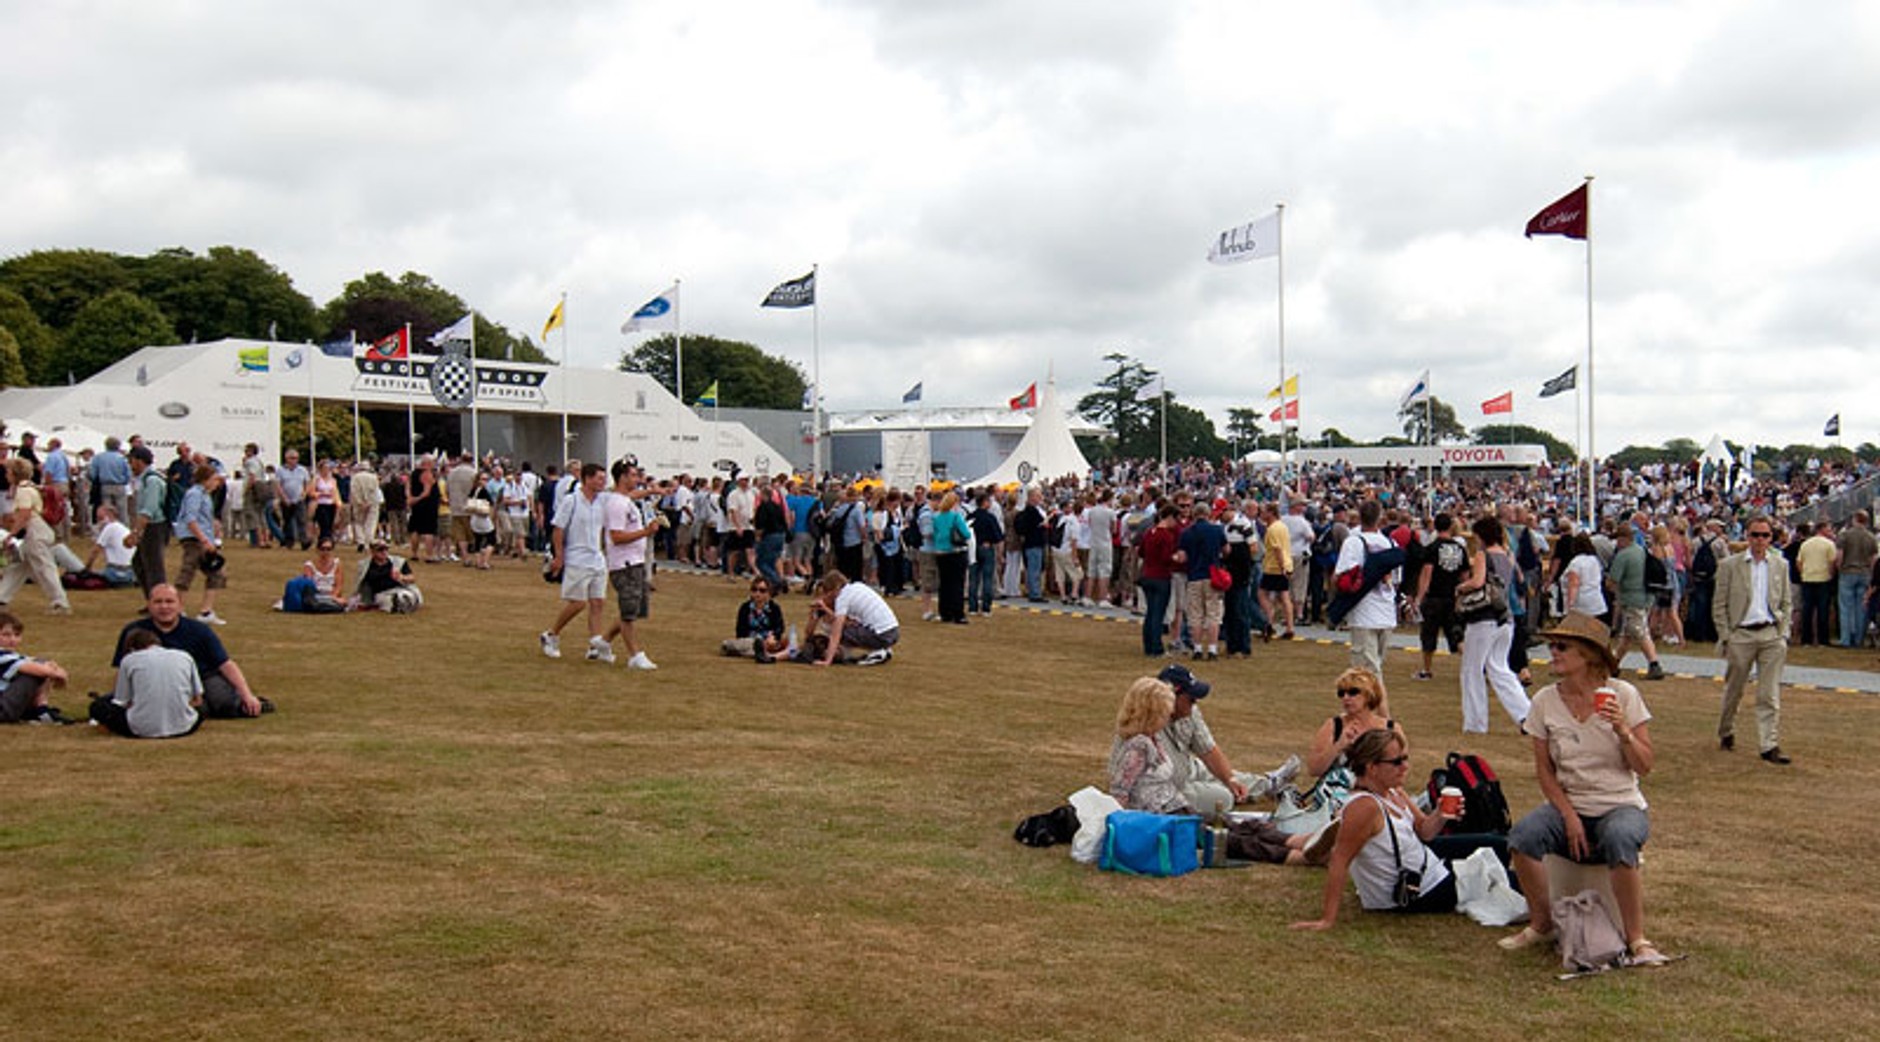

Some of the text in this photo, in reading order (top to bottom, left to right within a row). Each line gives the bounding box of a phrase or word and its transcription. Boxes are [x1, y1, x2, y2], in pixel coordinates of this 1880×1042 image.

[364, 361, 537, 385] GOOD WOOD
[364, 378, 535, 399] FESTIVAL OF SPEED
[1443, 449, 1505, 461] TOYOTA
